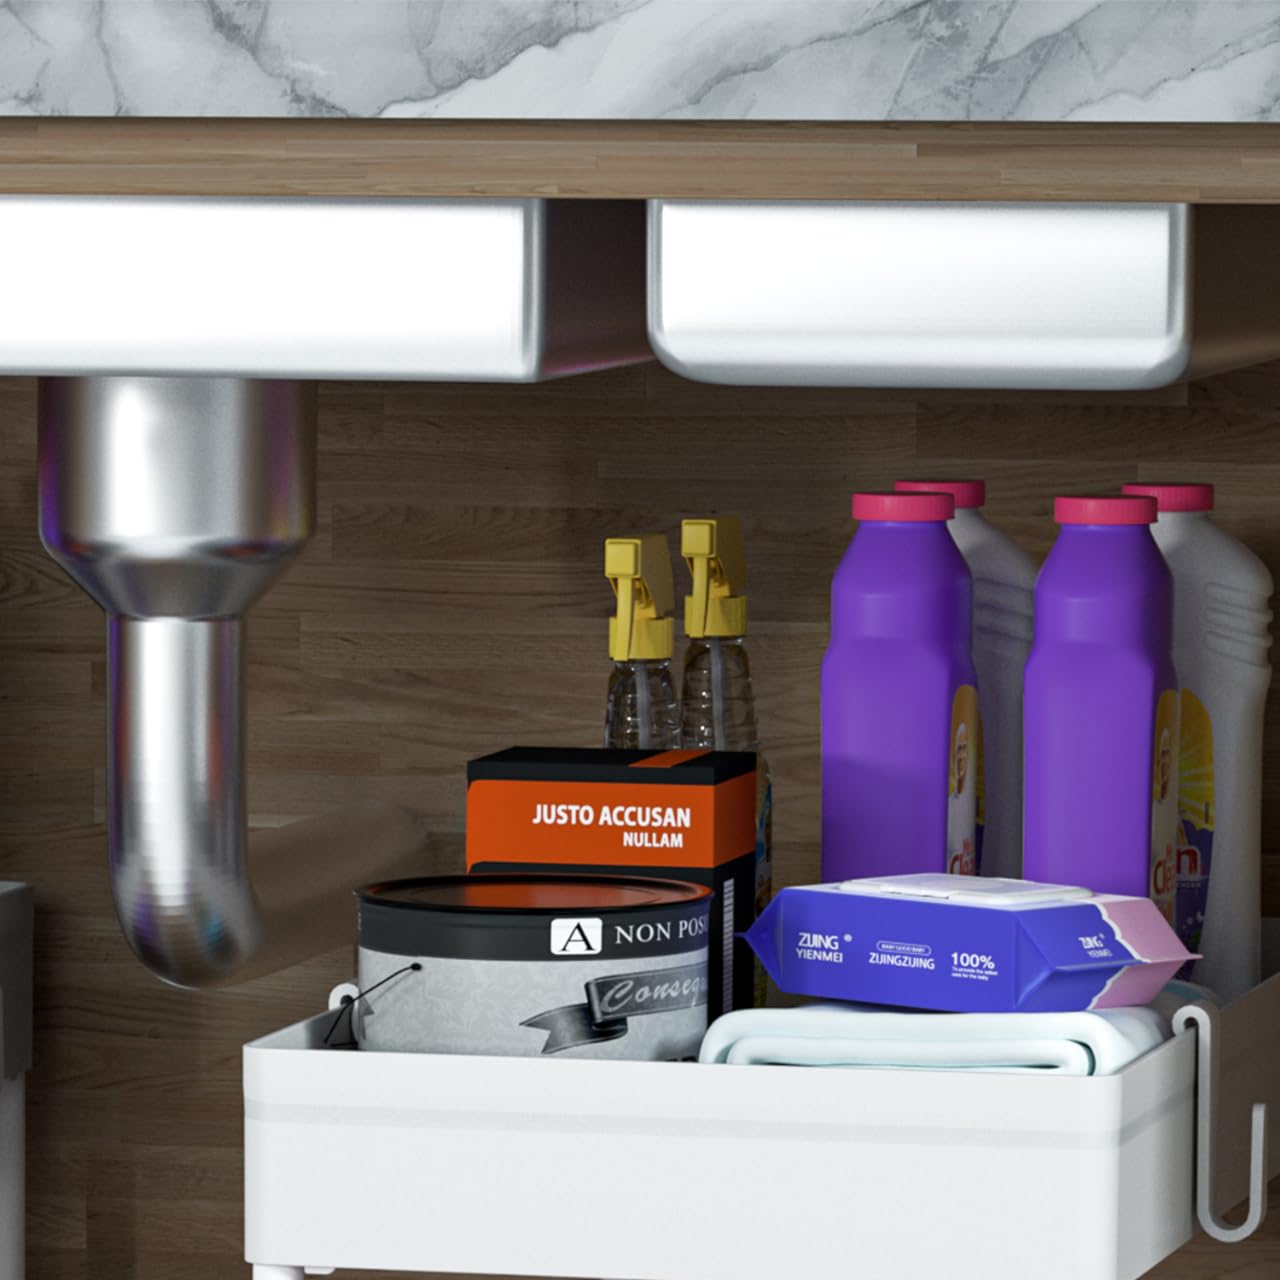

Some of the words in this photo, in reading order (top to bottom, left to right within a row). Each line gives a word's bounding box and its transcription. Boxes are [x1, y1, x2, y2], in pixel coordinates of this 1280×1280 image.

[532, 803, 594, 827] JUSTO
[598, 805, 692, 829] ACCUSAN
[622, 831, 683, 849] NULLAM
[561, 921, 595, 952] A
[614, 921, 672, 945] NON
[795, 948, 844, 964] YIENMEI
[868, 951, 936, 971] ZIJINGZIJING
[951, 951, 996, 970] 100%
